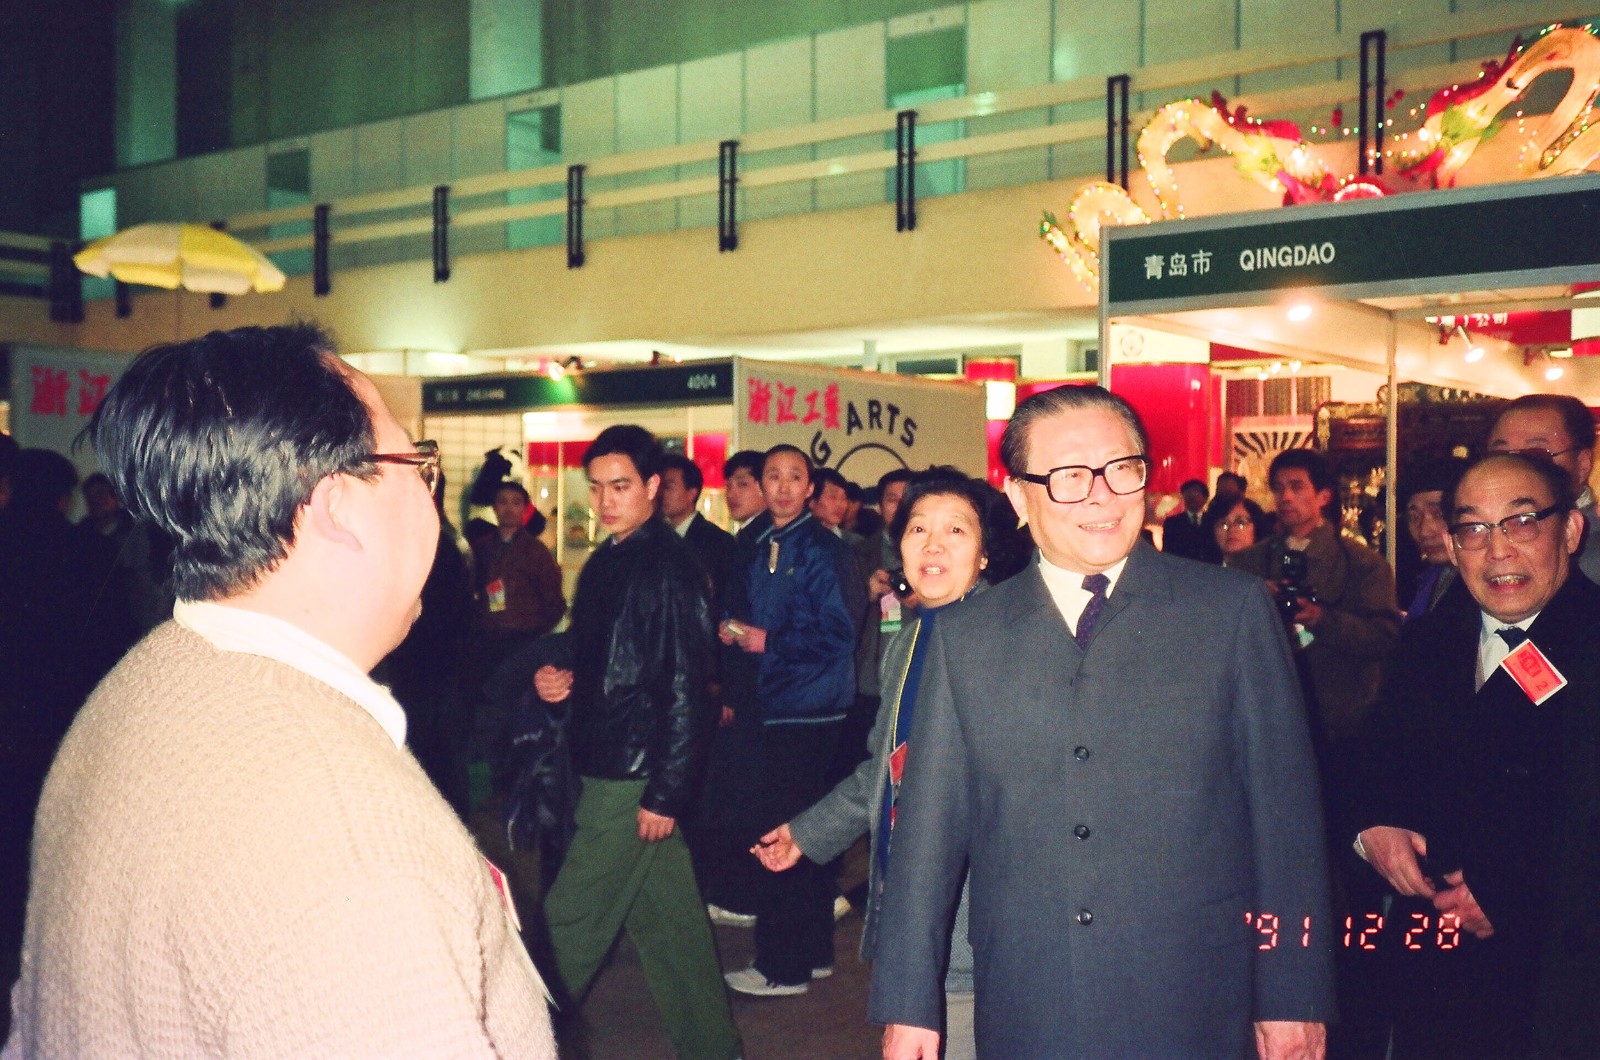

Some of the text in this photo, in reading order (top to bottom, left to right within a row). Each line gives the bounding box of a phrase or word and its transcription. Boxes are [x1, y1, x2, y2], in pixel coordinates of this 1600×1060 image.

[1144, 242, 1336, 280] 青岛市 QINGDAO
[846, 399, 918, 448] ARTS
